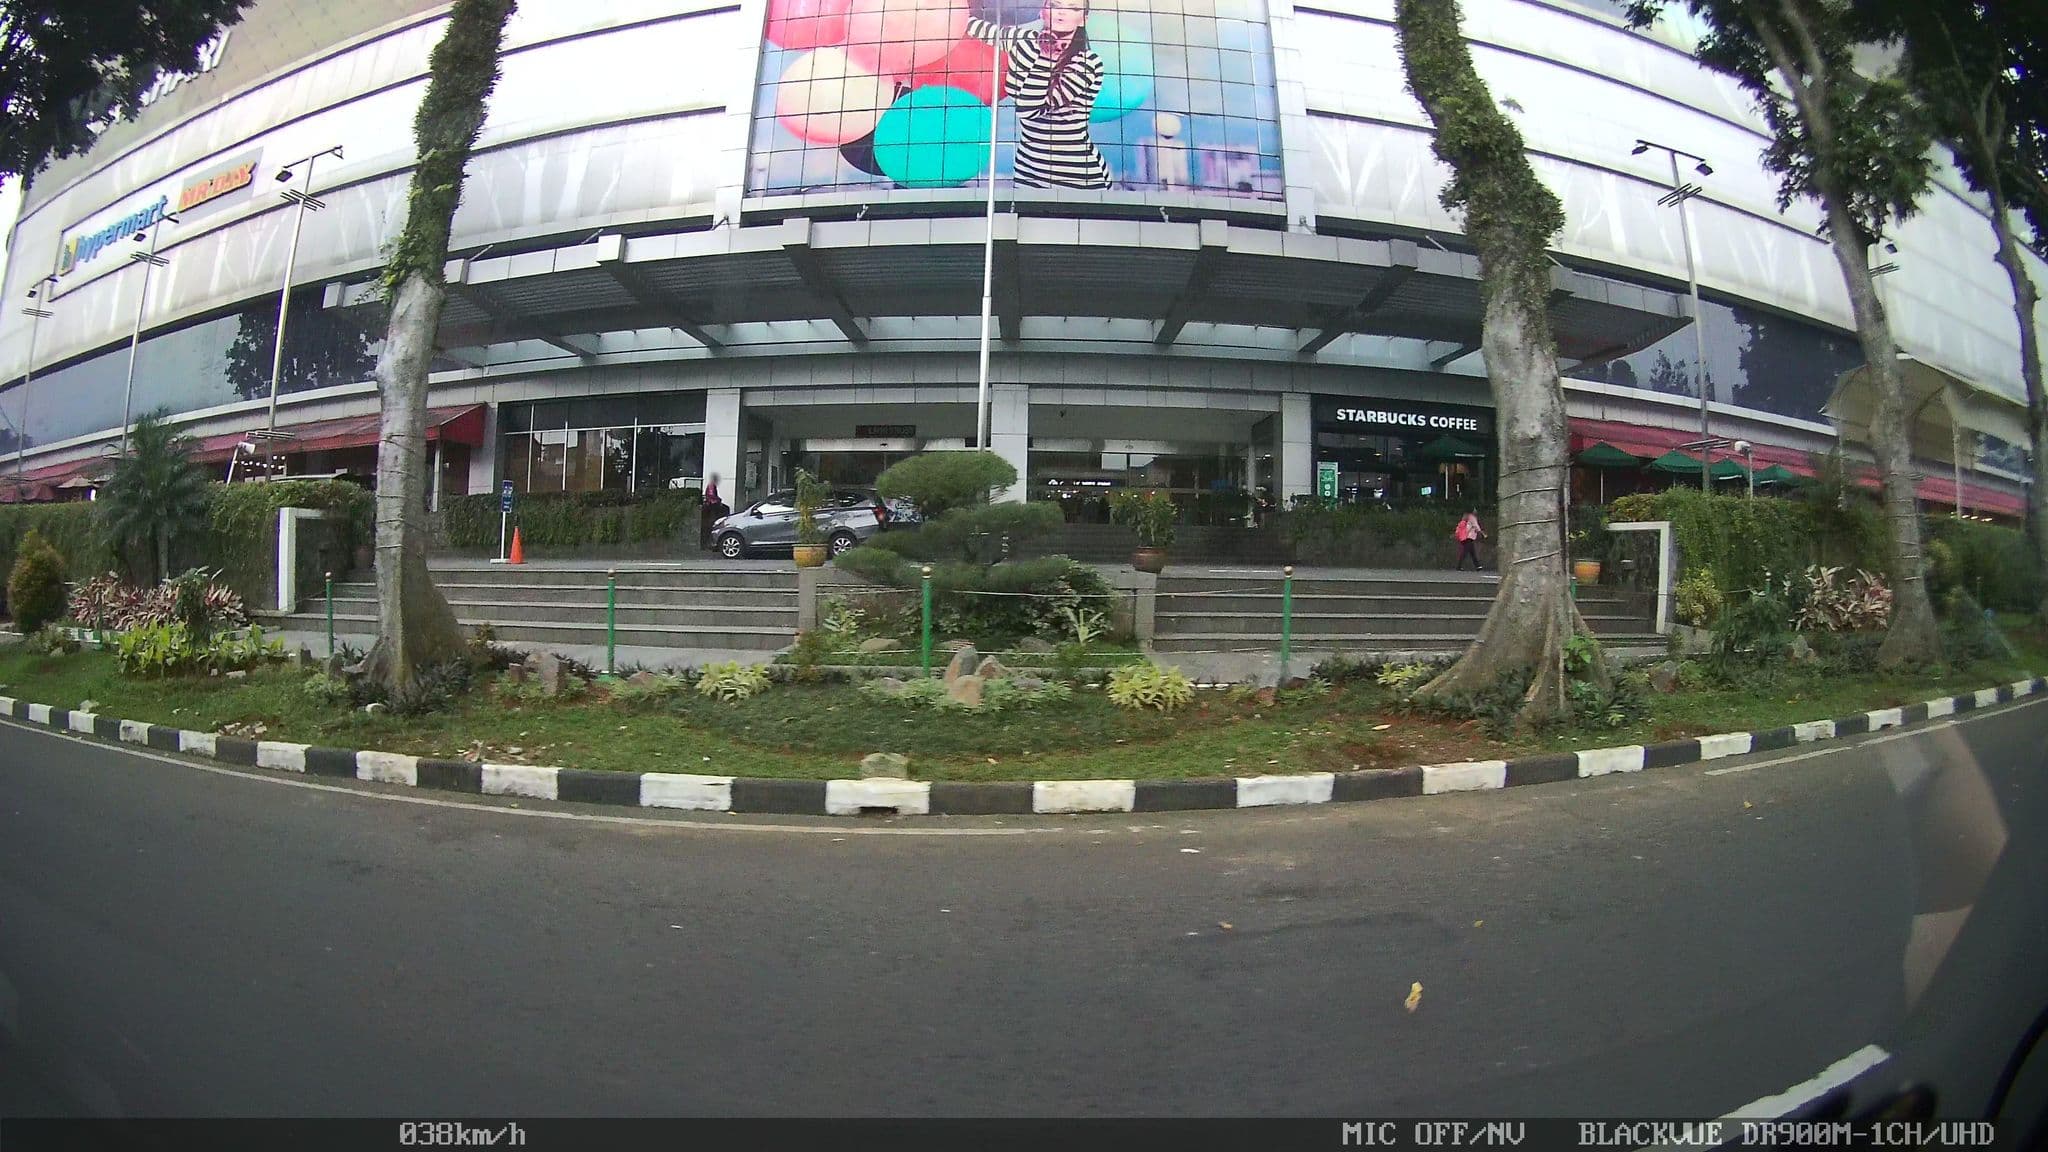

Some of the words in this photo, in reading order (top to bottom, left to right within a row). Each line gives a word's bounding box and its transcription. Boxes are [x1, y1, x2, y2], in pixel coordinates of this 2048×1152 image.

[77, 194, 168, 263] hypermart
[1336, 408, 1426, 426] STARBUCKS
[1429, 415, 1477, 431] COFFEE
